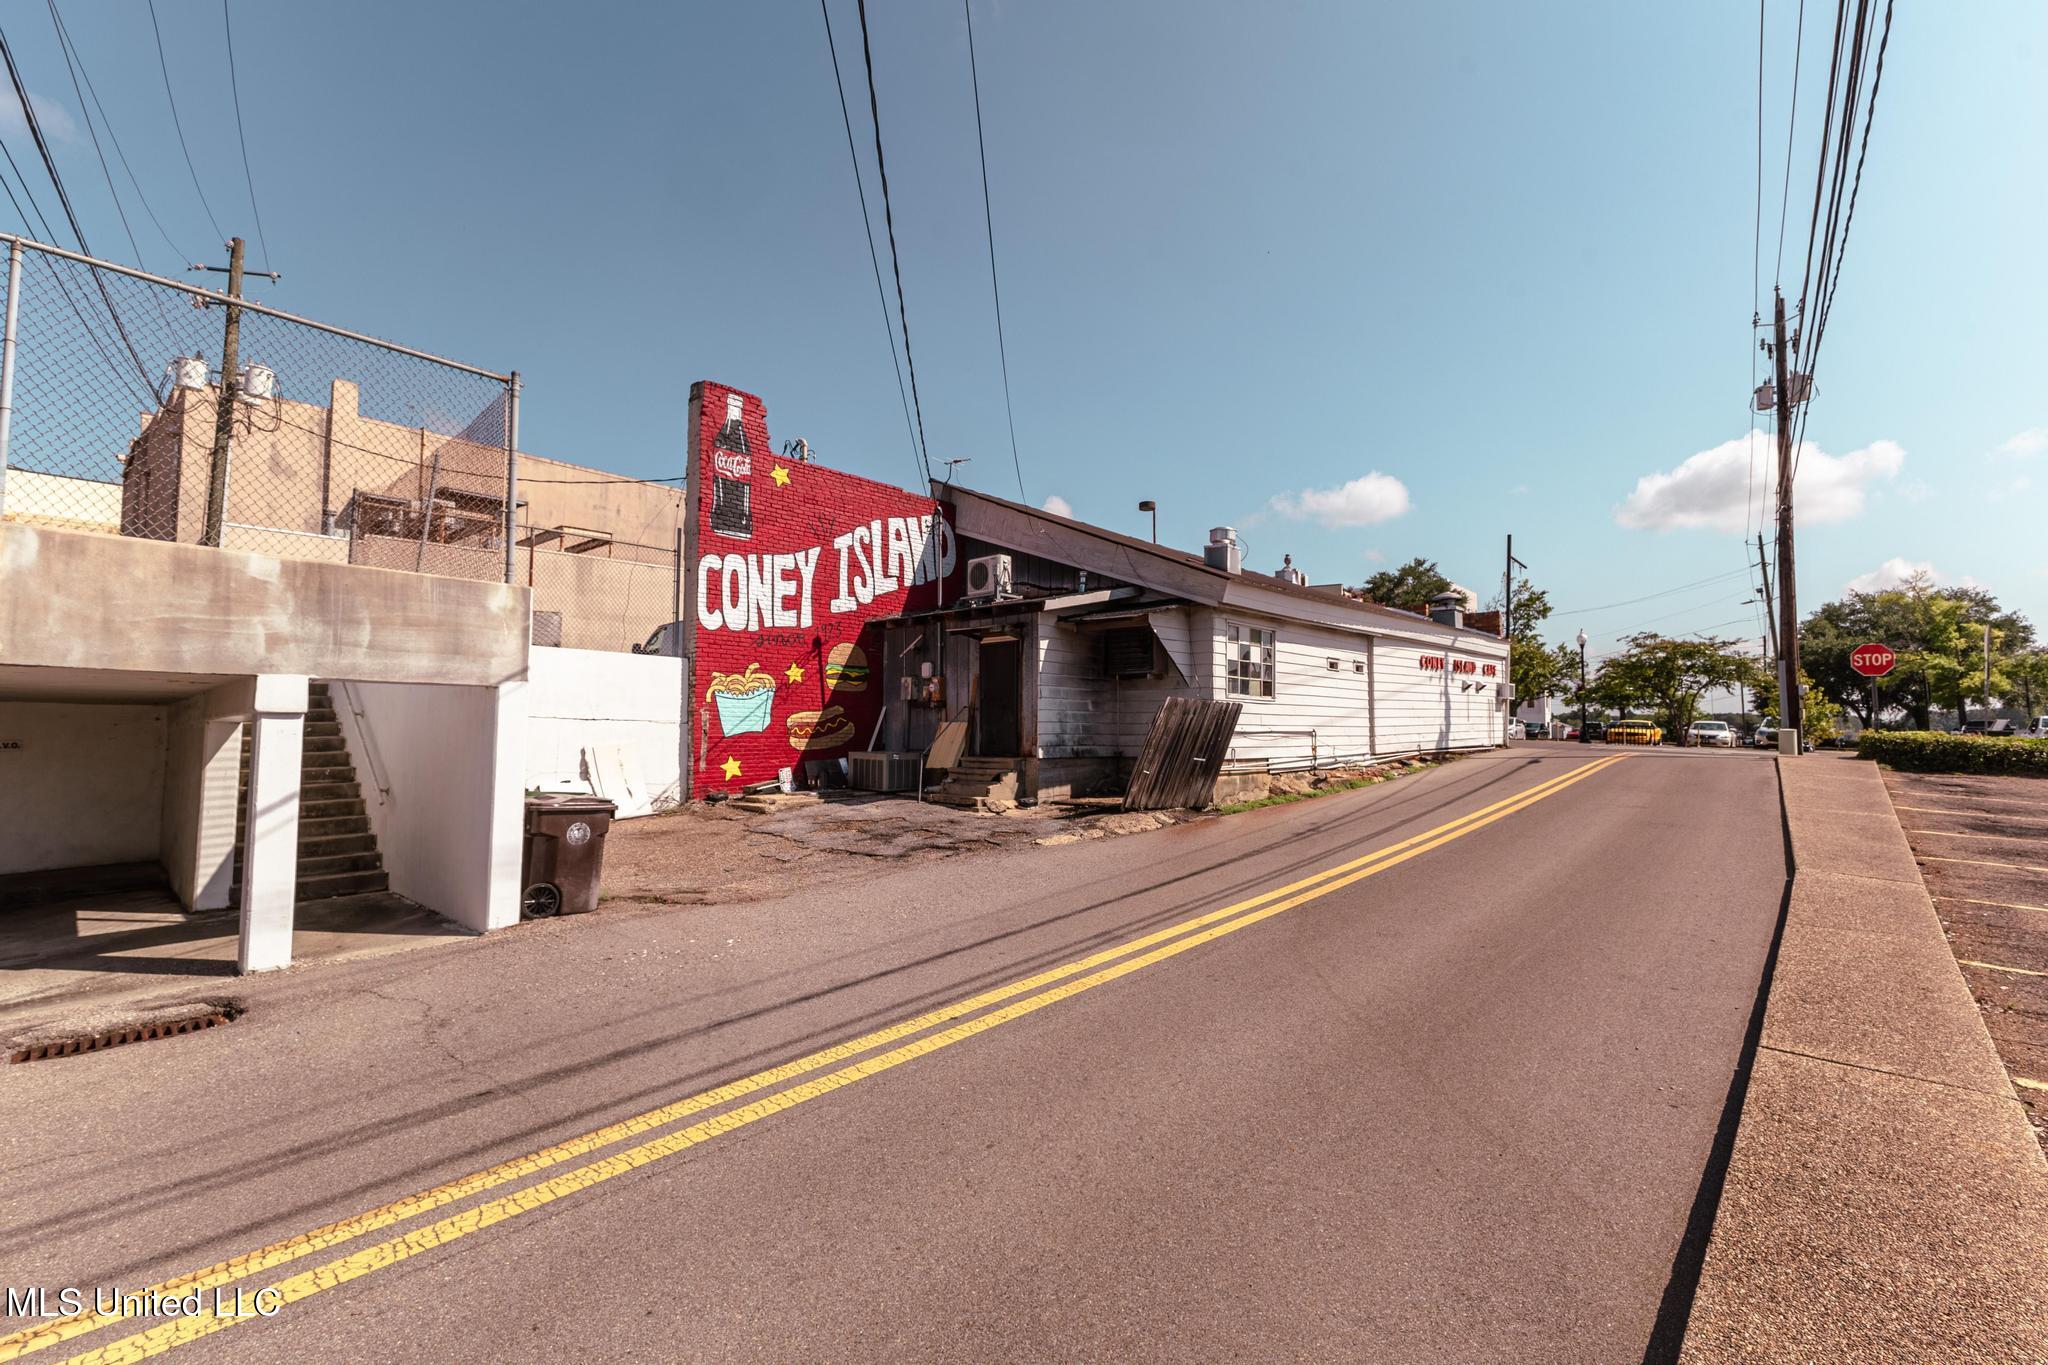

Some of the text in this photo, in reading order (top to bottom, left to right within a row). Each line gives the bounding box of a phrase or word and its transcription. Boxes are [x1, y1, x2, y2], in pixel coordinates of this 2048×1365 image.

[697, 513, 957, 632] CONEY ISLAND
[1853, 653, 1892, 666] STOP
